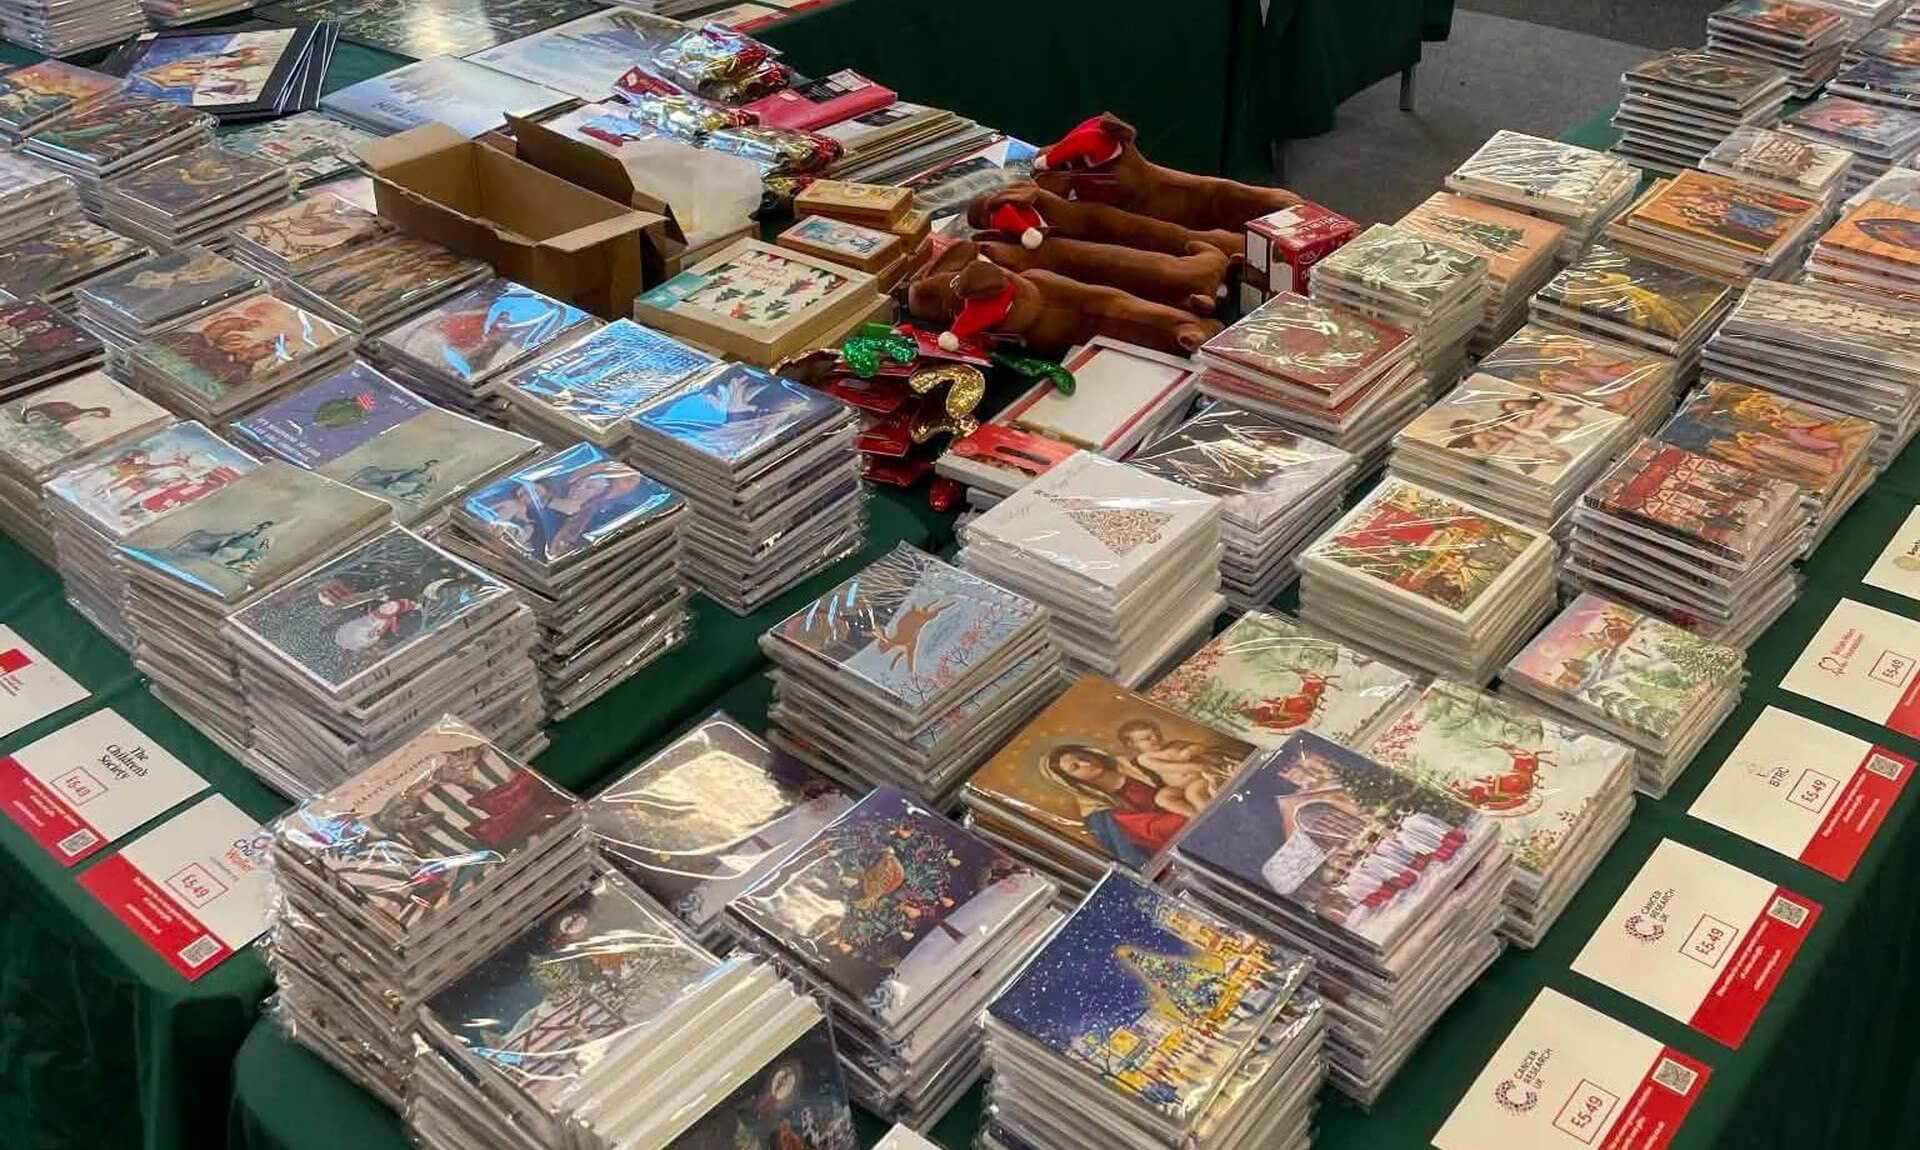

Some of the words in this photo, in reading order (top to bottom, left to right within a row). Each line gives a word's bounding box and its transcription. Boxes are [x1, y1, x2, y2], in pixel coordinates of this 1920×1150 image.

[98, 753, 130, 781] Society
[106, 744, 149, 778] Children's
[130, 746, 149, 762] The
[1801, 779, 1827, 804] £5.49
[181, 874, 210, 899] £5.49
[1641, 890, 1662, 915] CANCER
[1650, 888, 1676, 920] RESEARCH
[1695, 927, 1725, 956] £5.49
[1513, 1050, 1538, 1080] CANCER
[1524, 1047, 1554, 1085] RESEARCH
[1532, 1078, 1546, 1091] UK
[1571, 1095, 1604, 1129] £5.49
